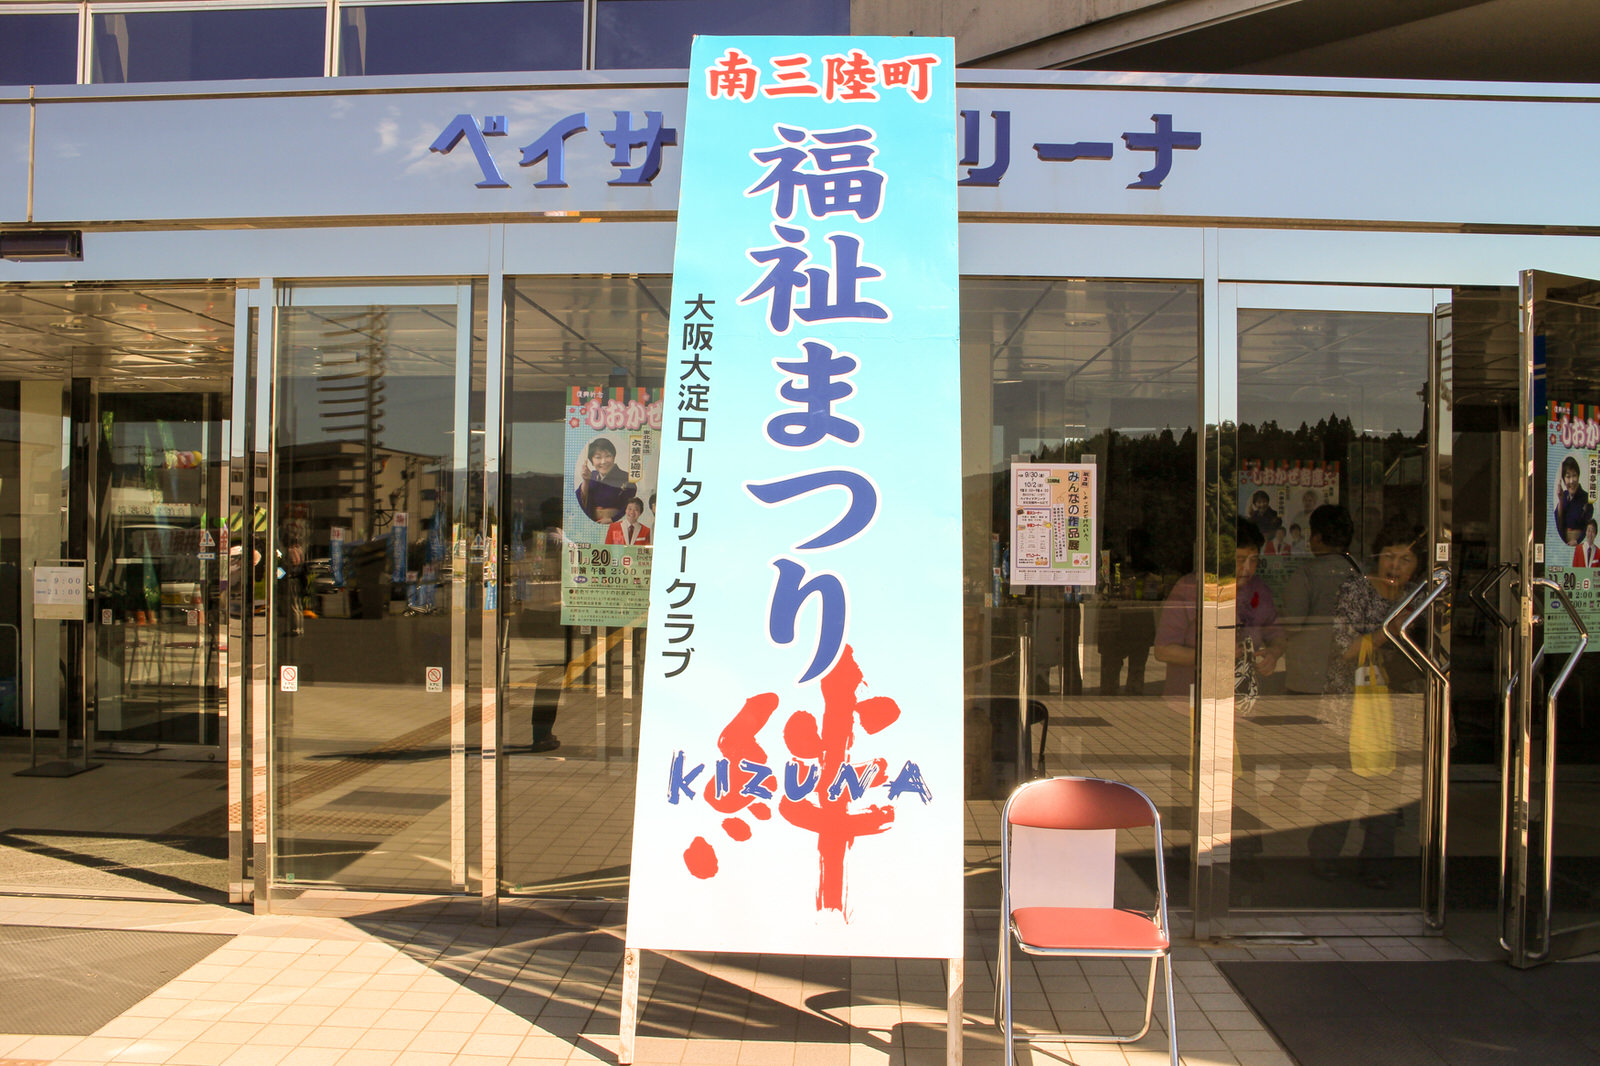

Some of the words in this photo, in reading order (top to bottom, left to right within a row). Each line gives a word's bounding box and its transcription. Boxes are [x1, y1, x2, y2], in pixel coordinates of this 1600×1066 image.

[706, 50, 939, 102] 南三陸町
[429, 111, 677, 188] ベイサ
[958, 110, 1202, 190] リーナ
[741, 125, 889, 685] 福祉まつり
[661, 293, 716, 679] 大阪大淀ロータリークラブ
[1067, 471, 1080, 551] みんなの作品展
[667, 750, 933, 805] KIZUNA
[682, 643, 902, 925] 絆
